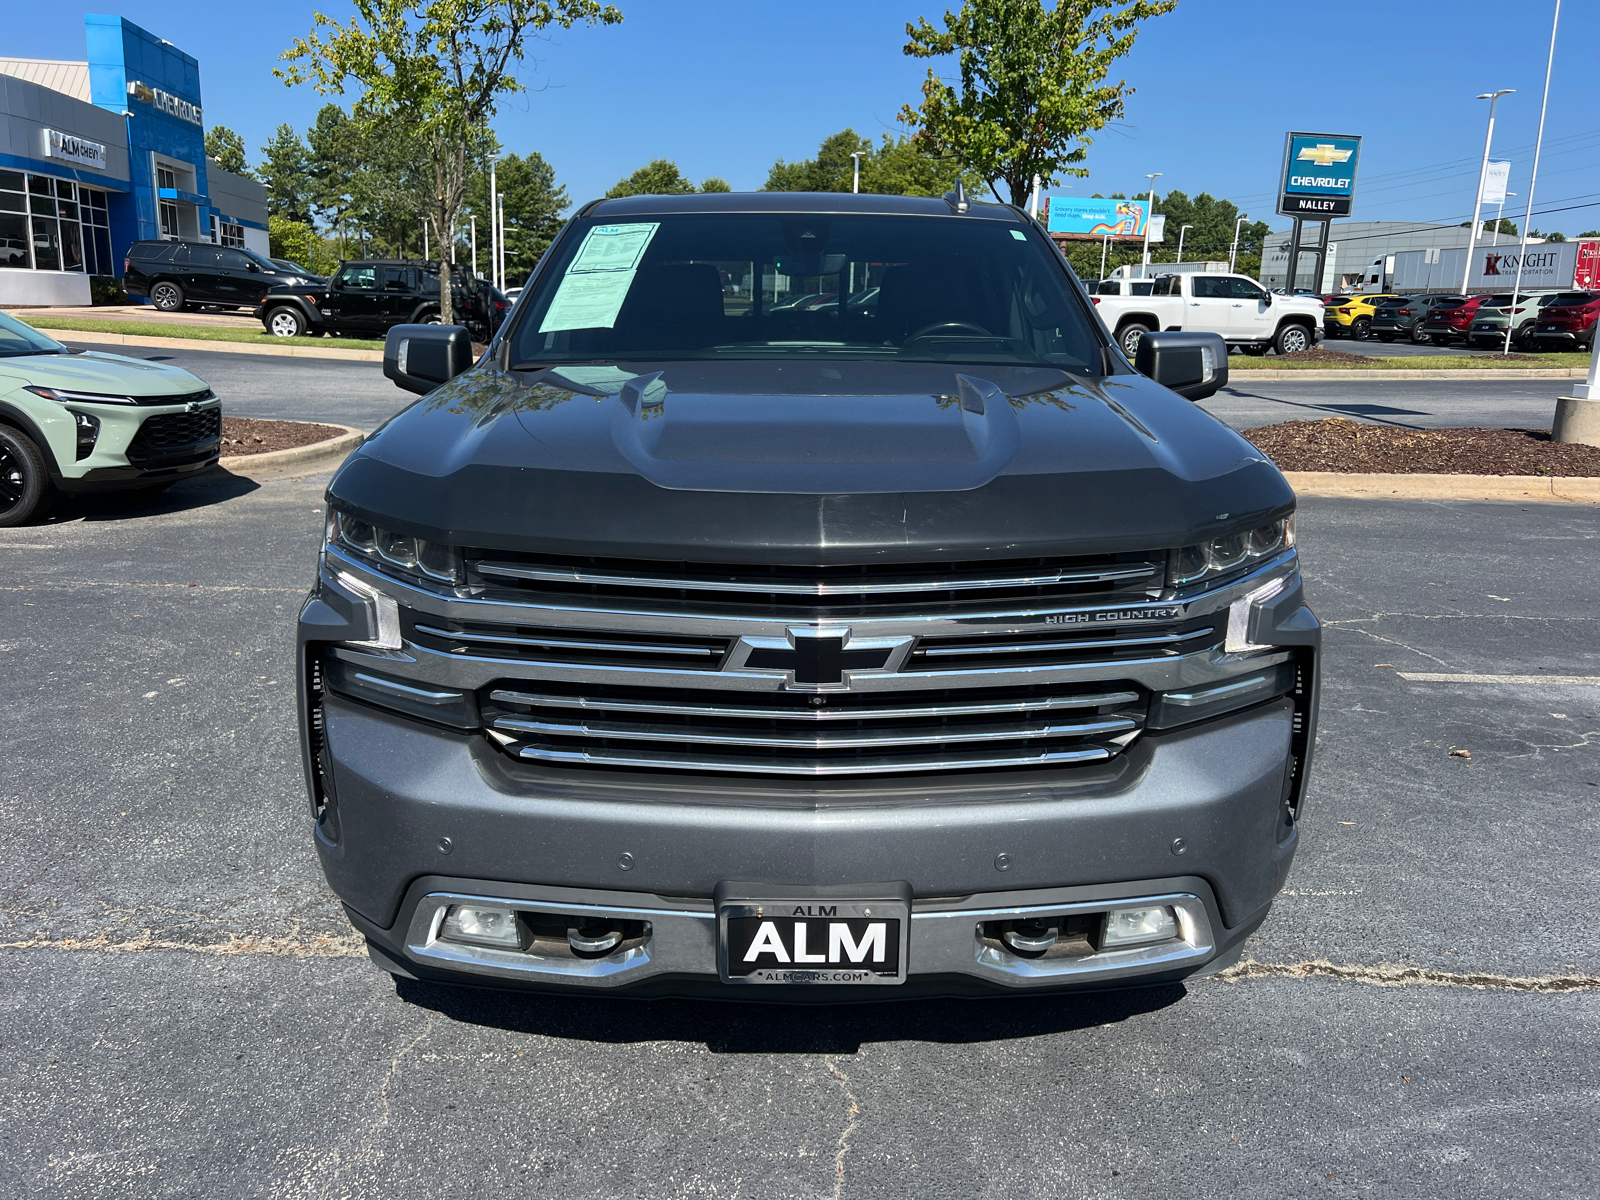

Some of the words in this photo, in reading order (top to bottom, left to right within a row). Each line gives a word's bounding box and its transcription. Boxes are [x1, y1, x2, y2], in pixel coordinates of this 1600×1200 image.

[153, 88, 204, 127] CHEVROLET
[61, 138, 80, 157] ALM
[80, 145, 99, 160] CHEVY
[1291, 176, 1350, 188] CHEVROLET
[1055, 206, 1073, 214] Grocery
[1299, 200, 1335, 210] NALLEY
[1502, 253, 1556, 268] KNIGHT
[1045, 614, 1089, 624] HIGH
[1095, 608, 1178, 621] COUNTRY
[792, 905, 837, 917] ALM
[743, 921, 886, 963] ALM
[765, 972, 862, 982] ALMCARS.COM
